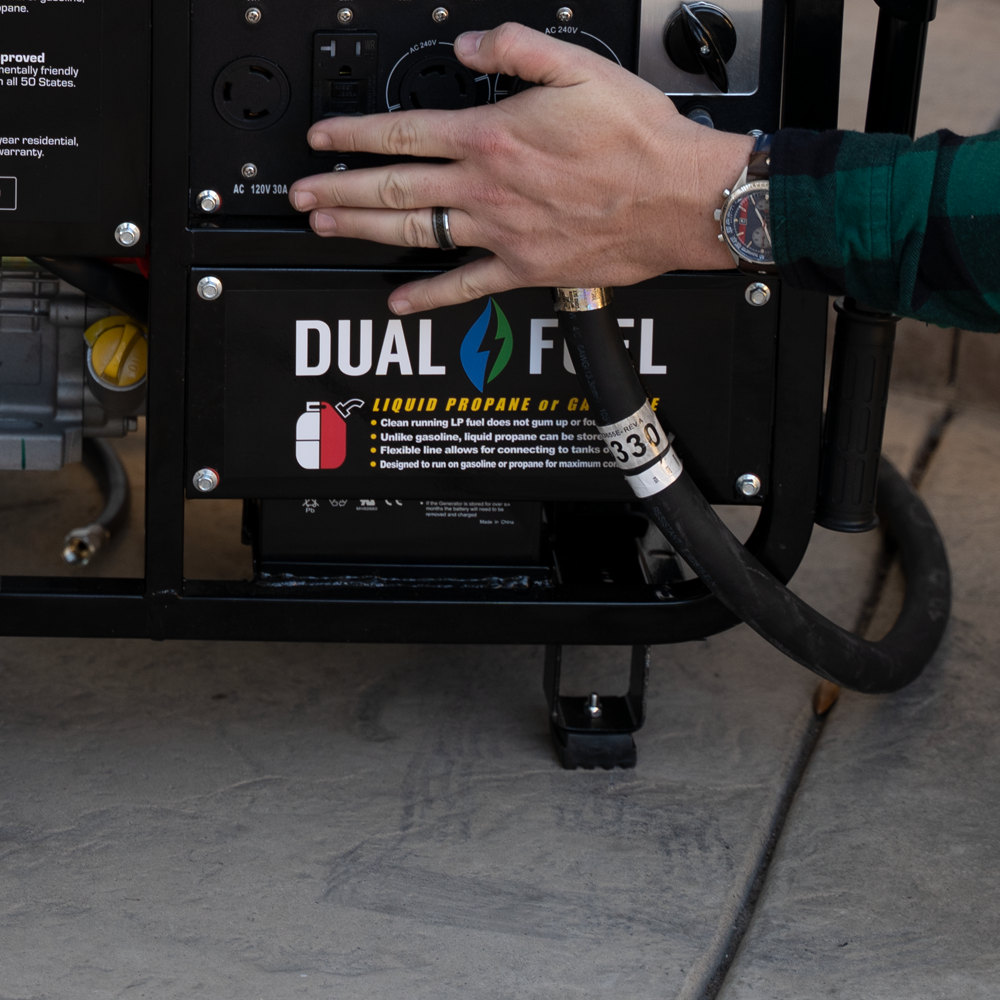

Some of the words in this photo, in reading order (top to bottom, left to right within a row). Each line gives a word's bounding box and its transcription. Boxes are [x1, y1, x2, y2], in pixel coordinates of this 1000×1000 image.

[545, 27, 556, 35] AC
[557, 26, 578, 35] 240V
[410, 45, 420, 53] AC
[420, 39, 437, 49] 240V
[41, 66, 79, 78] friendly
[22, 136, 78, 147] residential,
[233, 184, 244, 194] AC
[251, 184, 271, 194] 120V
[272, 184, 288, 194] 30A
[296, 319, 446, 376] DUAL
[372, 398, 438, 413] LIQUID
[445, 397, 531, 411] PROPANE
[539, 400, 559, 411] or
[380, 418, 409, 427] Clean
[411, 418, 449, 429] running
[451, 418, 464, 427] LP
[465, 418, 485, 427] fuel
[486, 418, 511, 426] does
[513, 418, 530, 426] not
[531, 420, 553, 428] gum
[556, 420, 568, 428] up
[380, 433, 413, 442] Unlike
[415, 432, 462, 443] gasoline,
[464, 432, 492, 443] liquid
[494, 434, 537, 443] propane
[561, 432, 574, 440] be
[610, 423, 660, 463] 330
